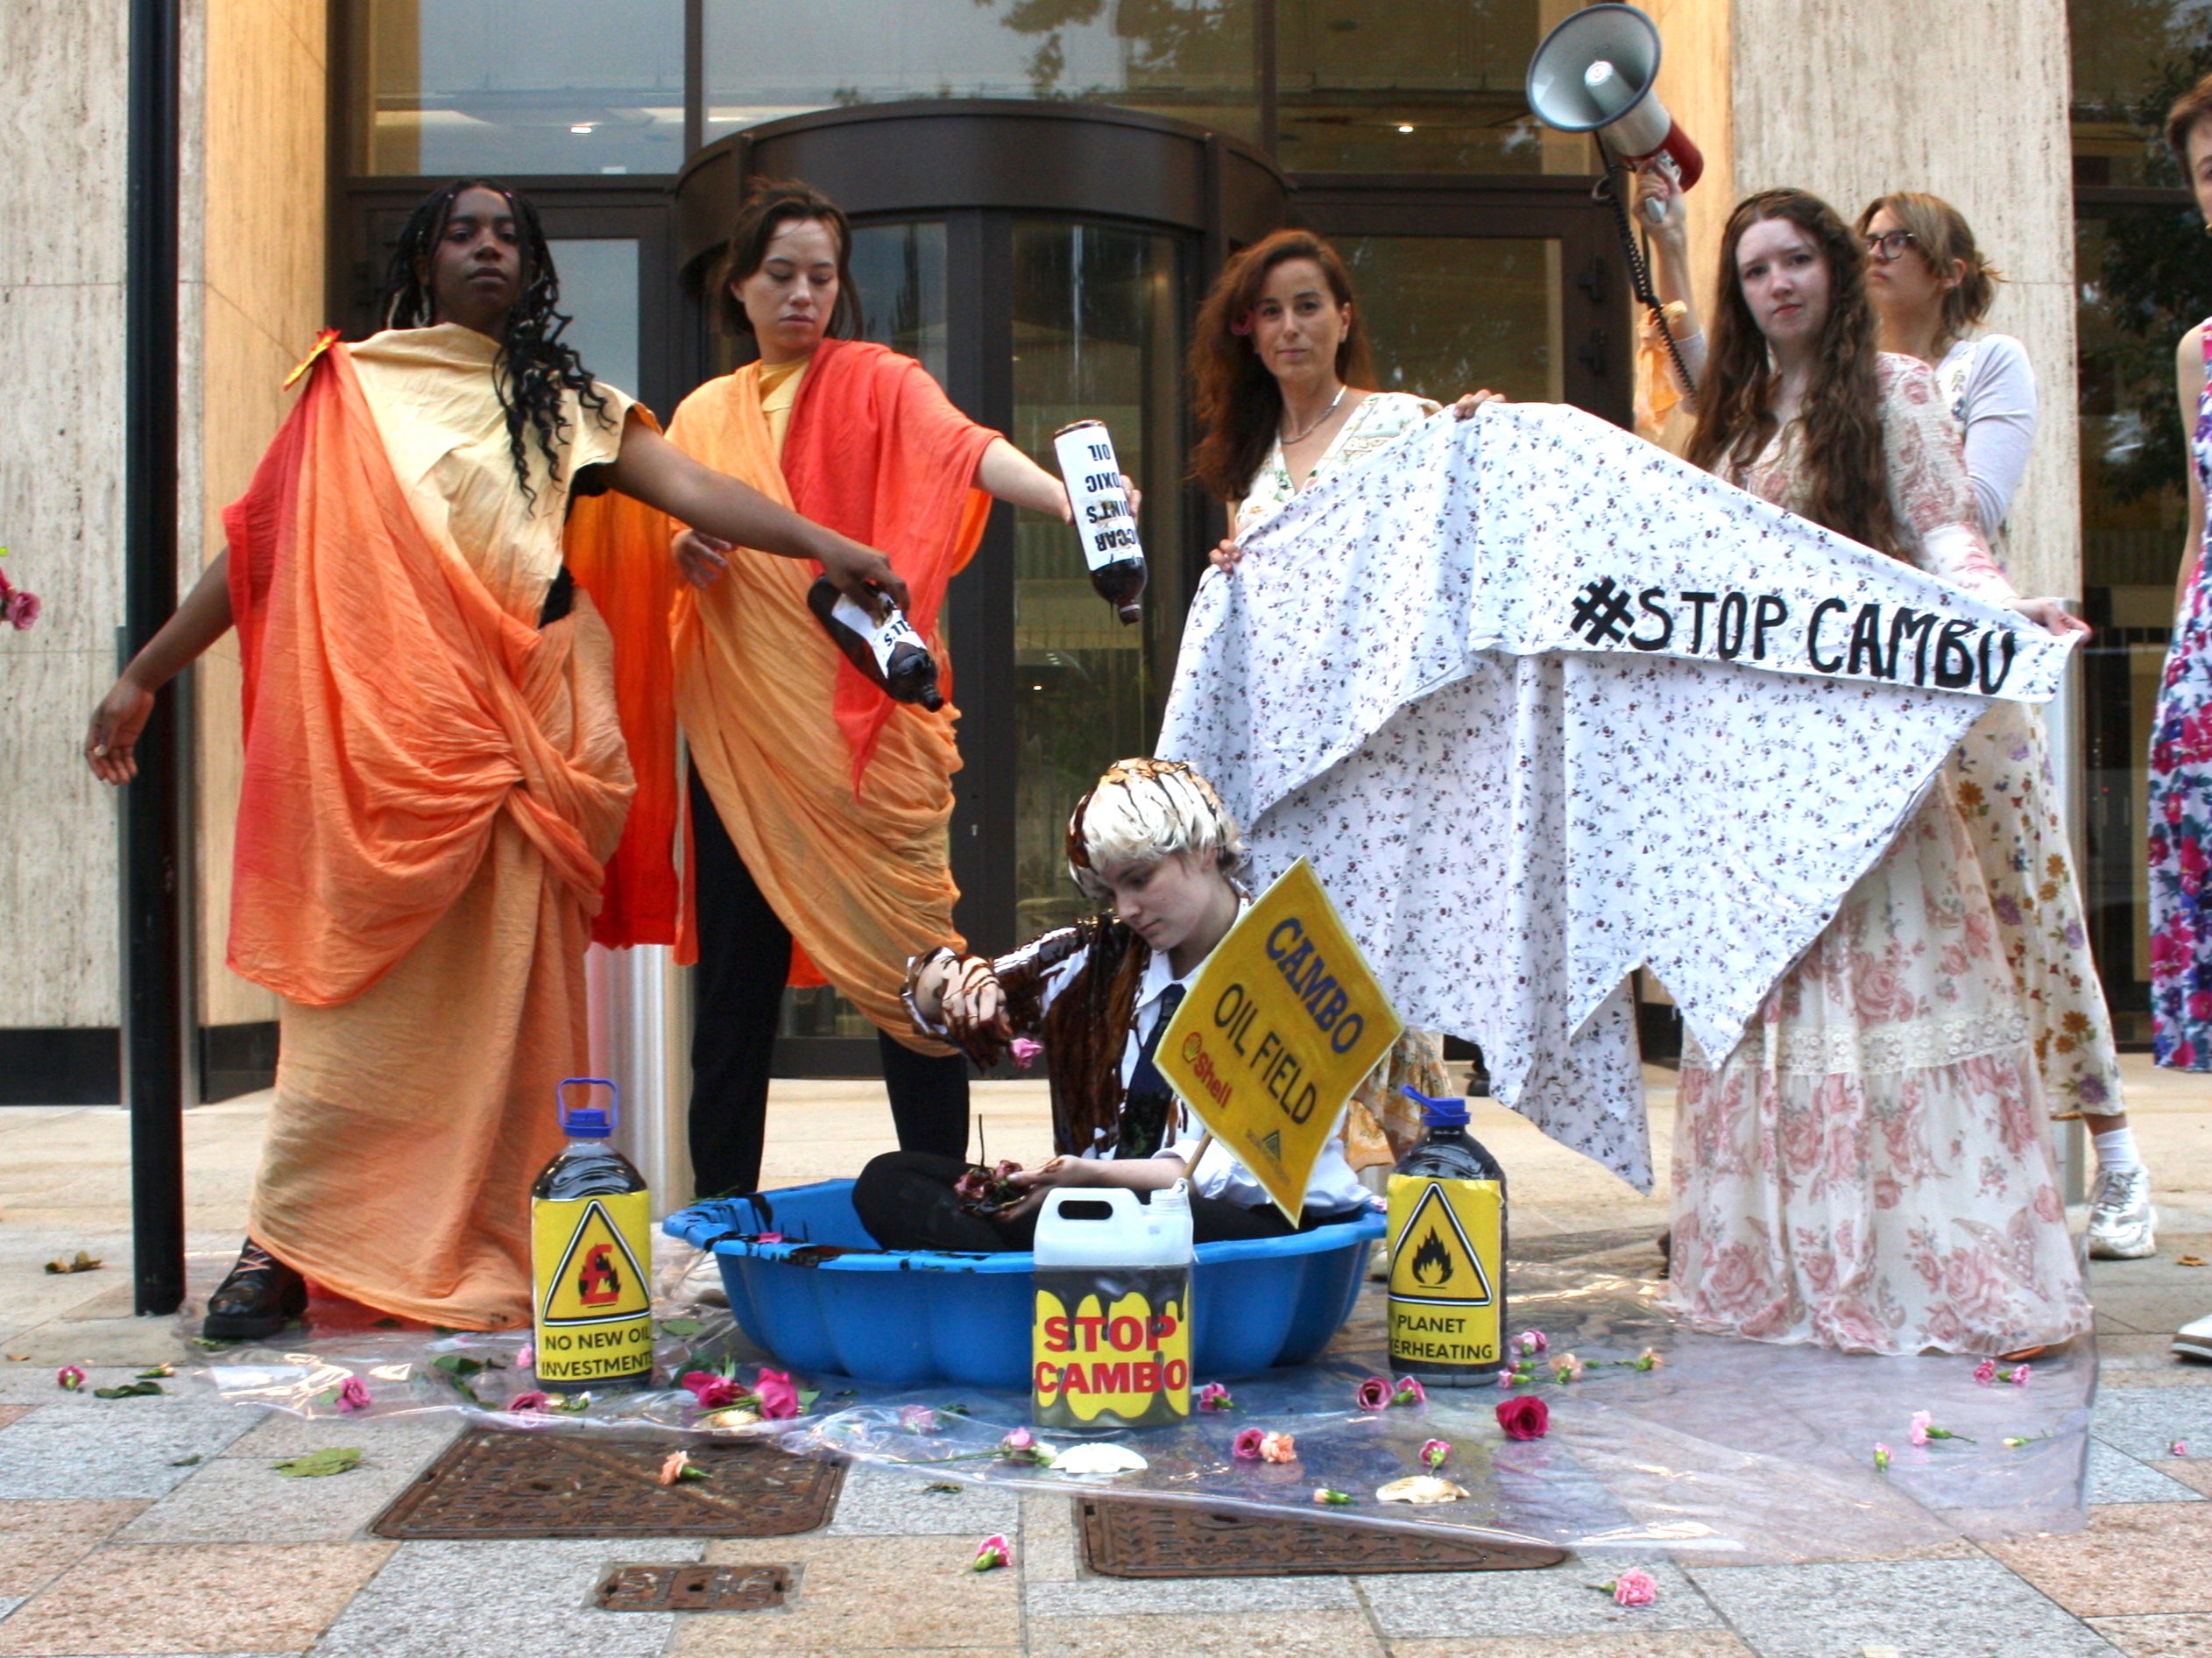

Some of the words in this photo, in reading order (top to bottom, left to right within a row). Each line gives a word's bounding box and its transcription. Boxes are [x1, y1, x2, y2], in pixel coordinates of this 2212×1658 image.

[1087, 444, 1111, 461] OIL
[1094, 528, 1138, 552] CCAR
[1570, 575, 1788, 661] #STOP
[1266, 917, 1364, 1054] CAMBO
[1214, 984, 1257, 1056] OIL
[1250, 1031, 1317, 1125] FIELD
[1194, 1053, 1233, 1110] Shell
[545, 1335, 572, 1351] NO
[578, 1330, 624, 1350] NEW
[629, 1326, 651, 1344] OIL
[1043, 1316, 1177, 1352] STOP
[1397, 1315, 1466, 1334] PLANET
[1392, 1337, 1493, 1360] ERHEATING
[1035, 1359, 1188, 1394] CAMBO
